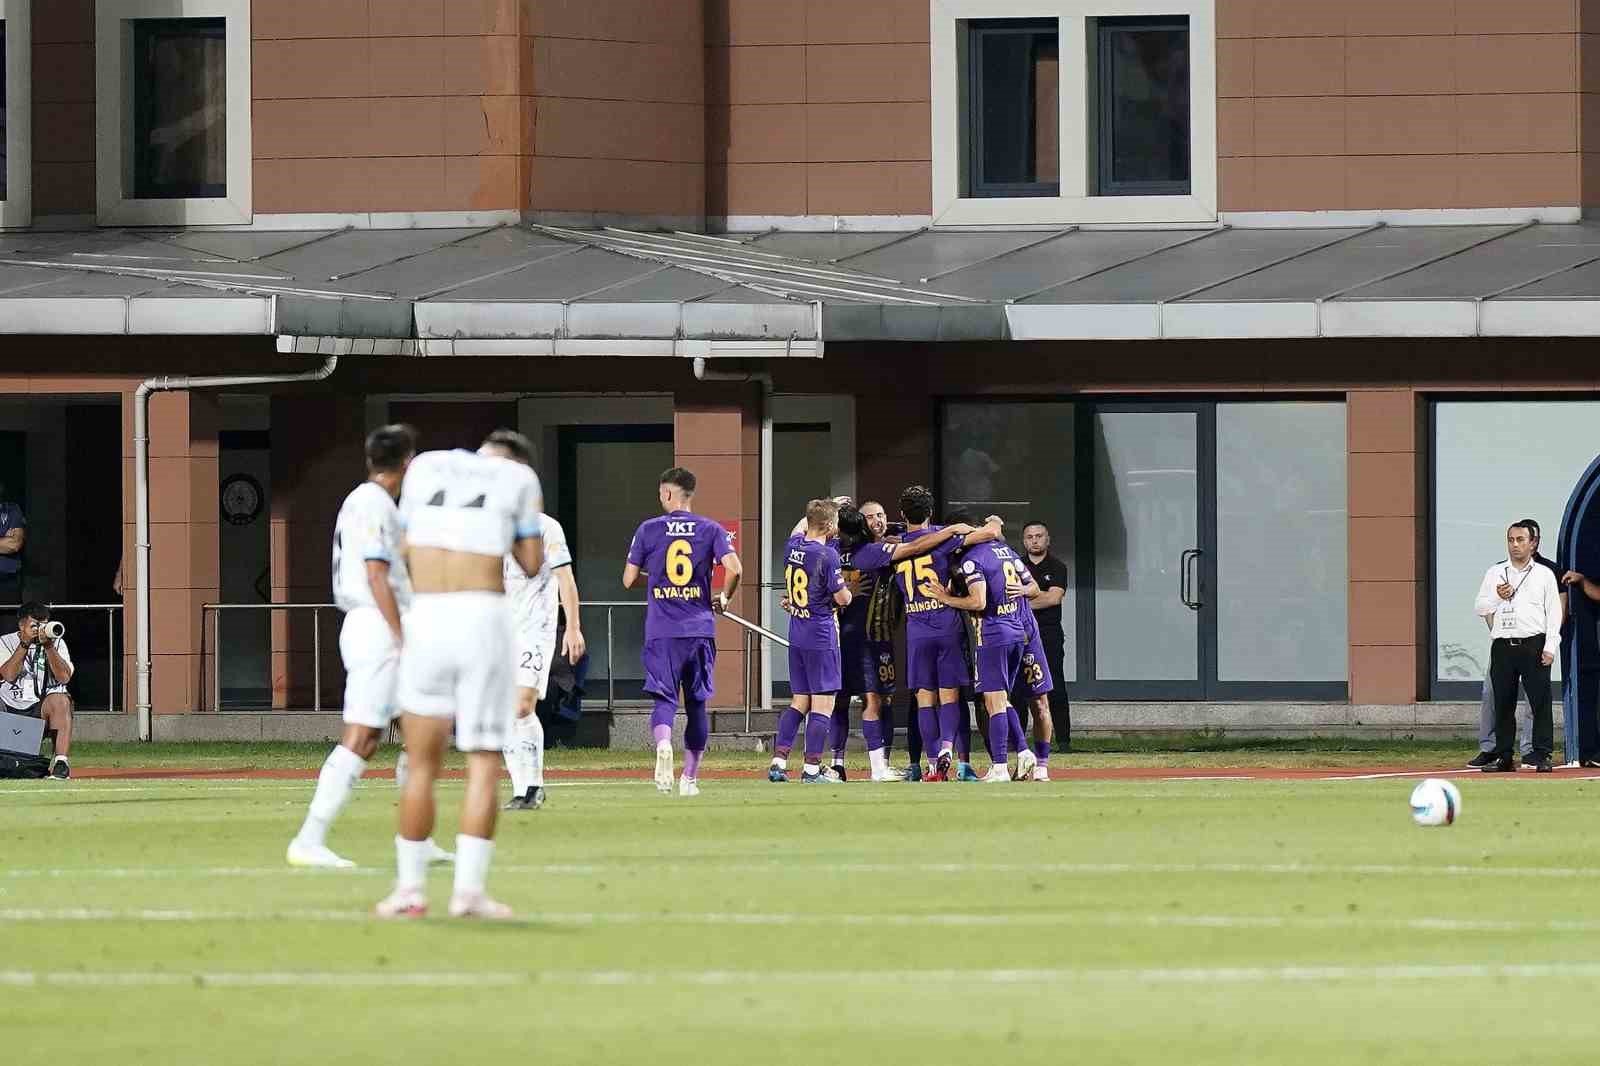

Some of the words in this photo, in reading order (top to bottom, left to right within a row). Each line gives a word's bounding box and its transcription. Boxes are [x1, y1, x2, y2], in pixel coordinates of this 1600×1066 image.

[666, 521, 696, 532] YKT
[666, 539, 693, 586] 6
[896, 554, 939, 601] 75
[785, 564, 808, 608] 18
